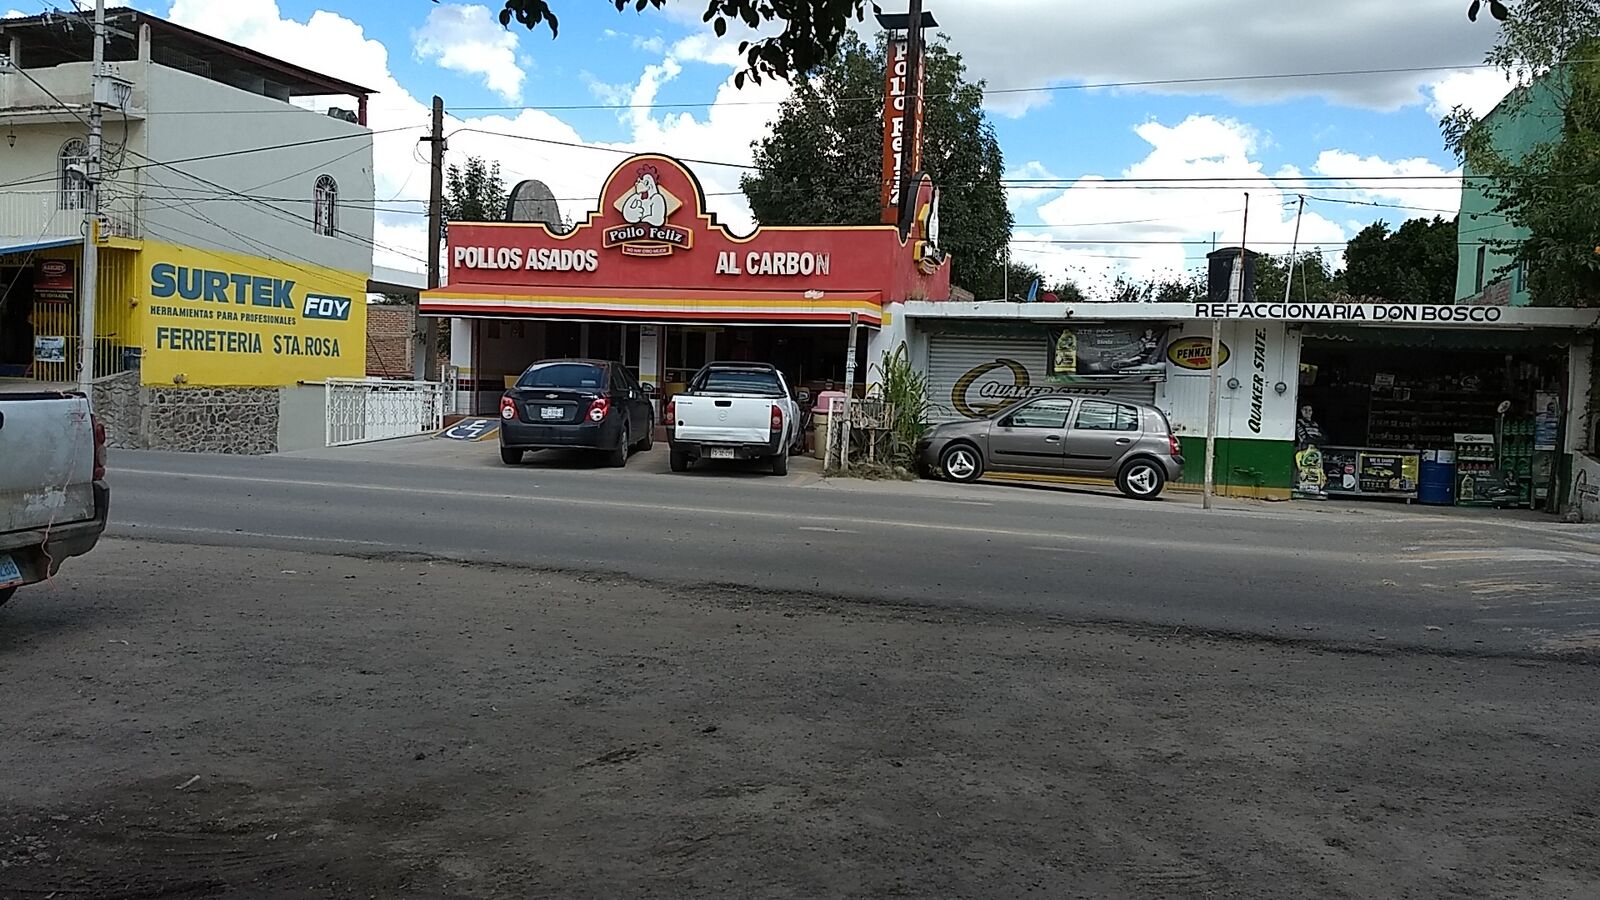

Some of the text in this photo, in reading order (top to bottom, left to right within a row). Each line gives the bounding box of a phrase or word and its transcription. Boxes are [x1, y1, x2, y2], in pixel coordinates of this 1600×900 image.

[609, 227, 683, 242] Pollo Feliz
[454, 246, 598, 272] POLLOS ASADOS
[715, 251, 830, 276] AL CARBON
[150, 262, 296, 309] SURTEK
[150, 305, 297, 326] HERRAMIENTAS PARA PROFESIONALES
[304, 297, 349, 317] FOY
[1195, 303, 1501, 322] REFACCIONARIA DON BOSCO
[156, 326, 262, 354] FERRETERIA
[1176, 346, 1213, 360] PENNZO
[1247, 373, 1264, 434] QUAKER
